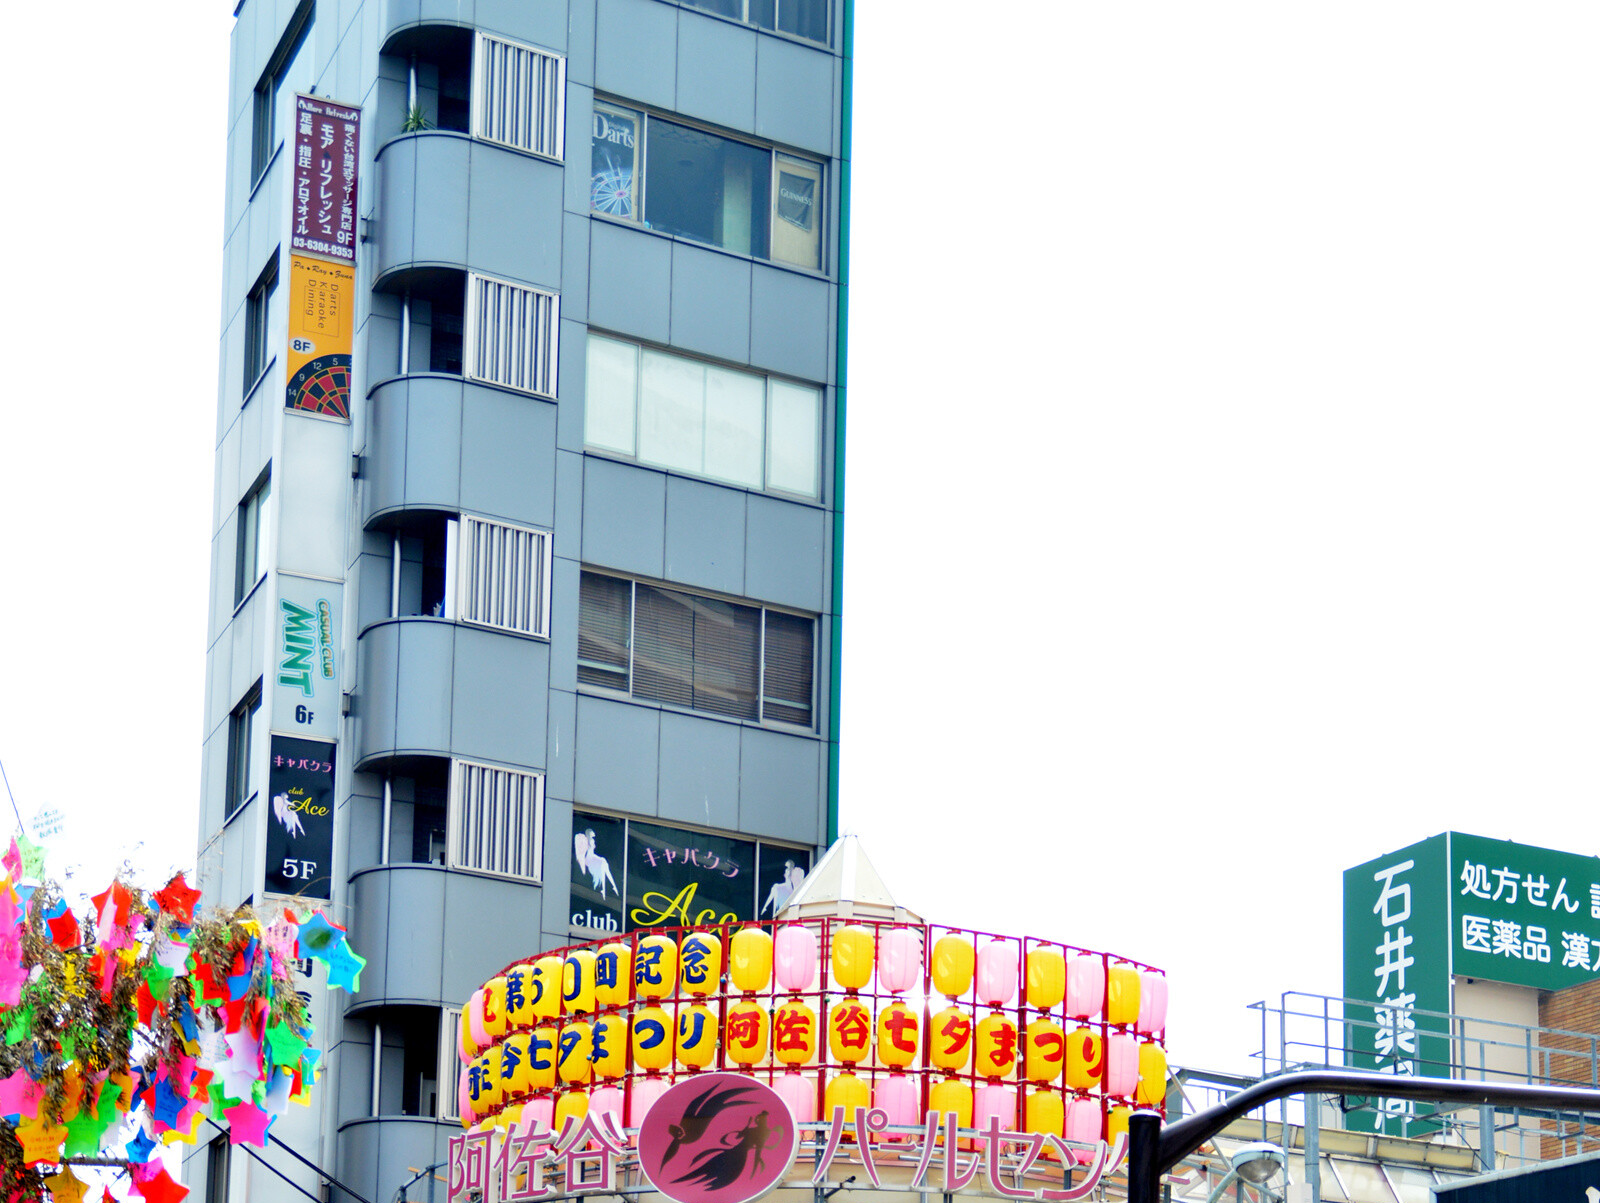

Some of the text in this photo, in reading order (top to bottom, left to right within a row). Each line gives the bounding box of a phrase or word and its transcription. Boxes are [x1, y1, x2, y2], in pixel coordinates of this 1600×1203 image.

[591, 113, 635, 149] Darts
[293, 237, 353, 258] 03-6304-9353
[337, 231, 353, 245] 9F
[305, 279, 317, 316] Dining
[317, 281, 327, 329] Karaoke
[329, 283, 339, 316] Darts
[293, 339, 311, 351] 8F
[313, 362, 322, 370] 12
[332, 357, 339, 366] 5
[299, 373, 305, 382] 9
[288, 388, 297, 396] 14
[279, 600, 316, 695] MINT
[318, 600, 333, 678] CASUAL CLUB
[295, 704, 314, 725] 6F
[273, 755, 332, 773] キャバクラ
[288, 786, 304, 795] club
[287, 797, 330, 817] Ace
[282, 858, 317, 880] 5F
[642, 847, 740, 878] キャバクラ
[1460, 860, 1580, 914] 処方せん
[571, 882, 746, 938] club Ace
[1462, 914, 1552, 964] 医薬品
[728, 1005, 1104, 1078] 阿佐谷七夕まつり
